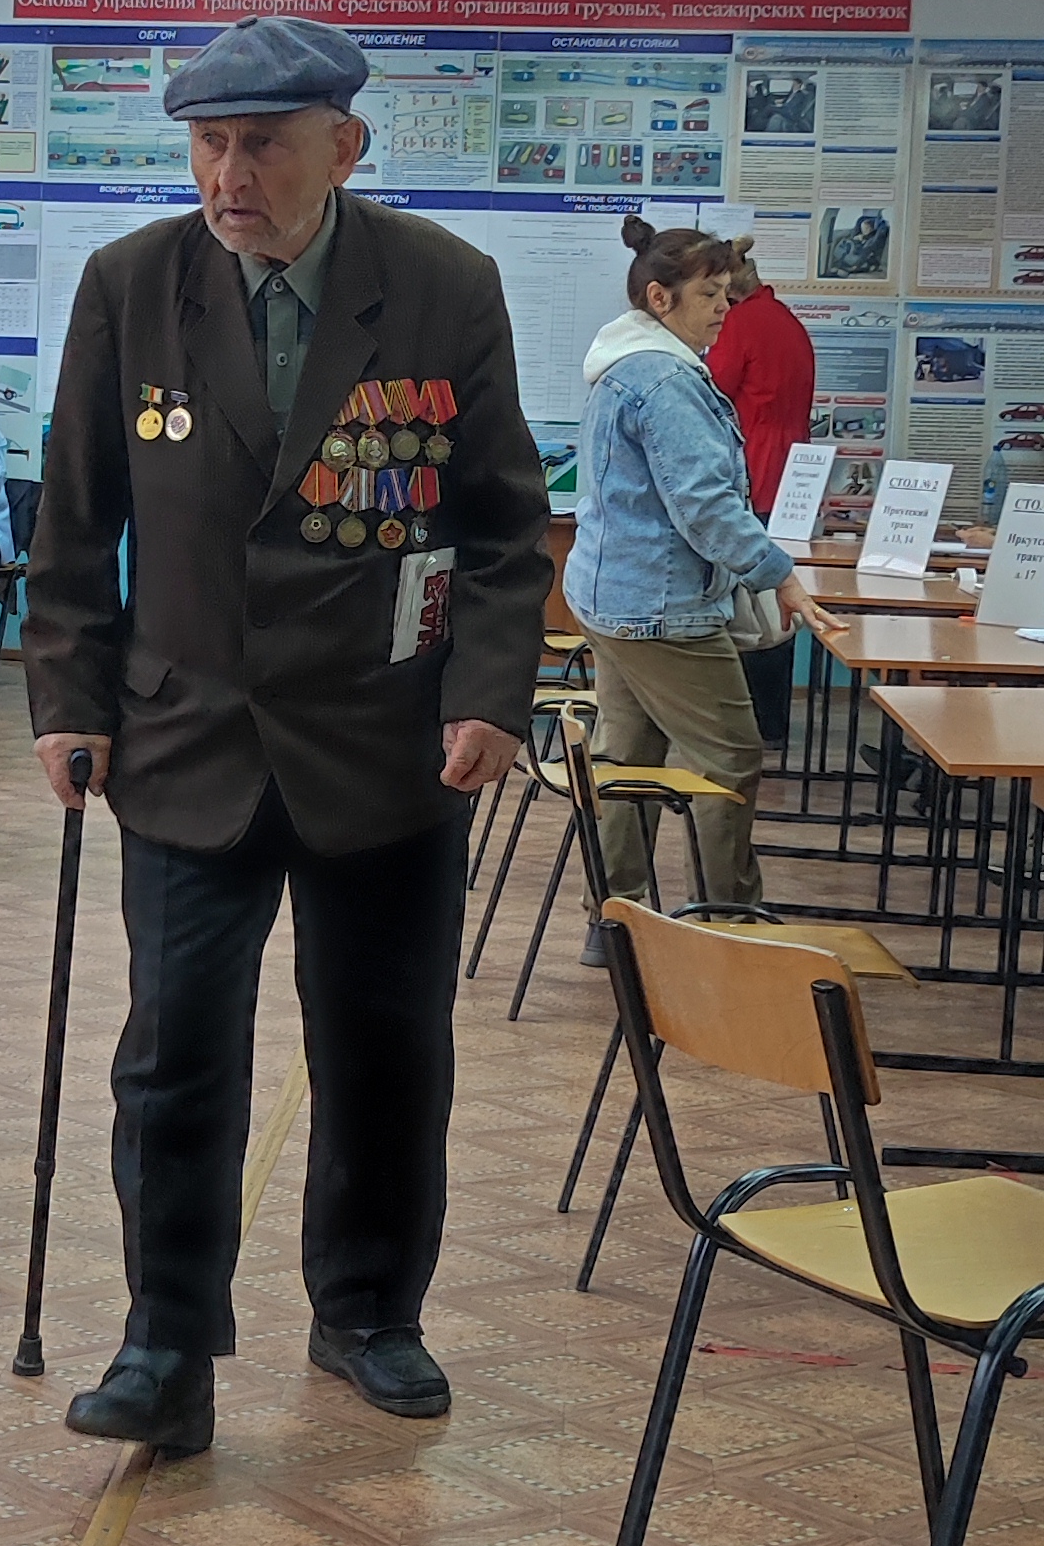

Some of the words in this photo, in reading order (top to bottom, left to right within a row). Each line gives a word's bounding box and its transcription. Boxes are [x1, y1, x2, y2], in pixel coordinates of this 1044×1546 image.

[437, 0, 449, 13] и
[455, 1, 568, 19] организация
[574, 1, 666, 21] грузовых,
[672, 2, 805, 22] пассажирских
[811, 4, 907, 24] перевозок
[138, 30, 176, 41] ОБГОН
[349, 34, 426, 45] ОРМОЖЕНИЕ
[551, 37, 616, 47] ОСТАНОВКА
[619, 38, 628, 48] И
[629, 38, 680, 48] СТОЯНКА
[145, 186, 157, 194] НА
[157, 186, 200, 194] СКОЛЬЗКО
[135, 195, 170, 203] ДОРОГЕ
[563, 195, 605, 203] ОПАСНЫЕ
[607, 196, 652, 204] СИТУАЦИИ
[588, 204, 640, 212] ПОВОРОТАХ
[889, 477, 919, 488] СТОЛ
[920, 479, 931, 489] №
[932, 480, 939, 490] 2
[883, 506, 929, 517] Иркутский
[891, 522, 914, 531] тракт
[891, 534, 902, 544] 13,
[905, 535, 914, 544] 14
[1016, 553, 1044, 564] тракт
[1024, 569, 1037, 580] 17
